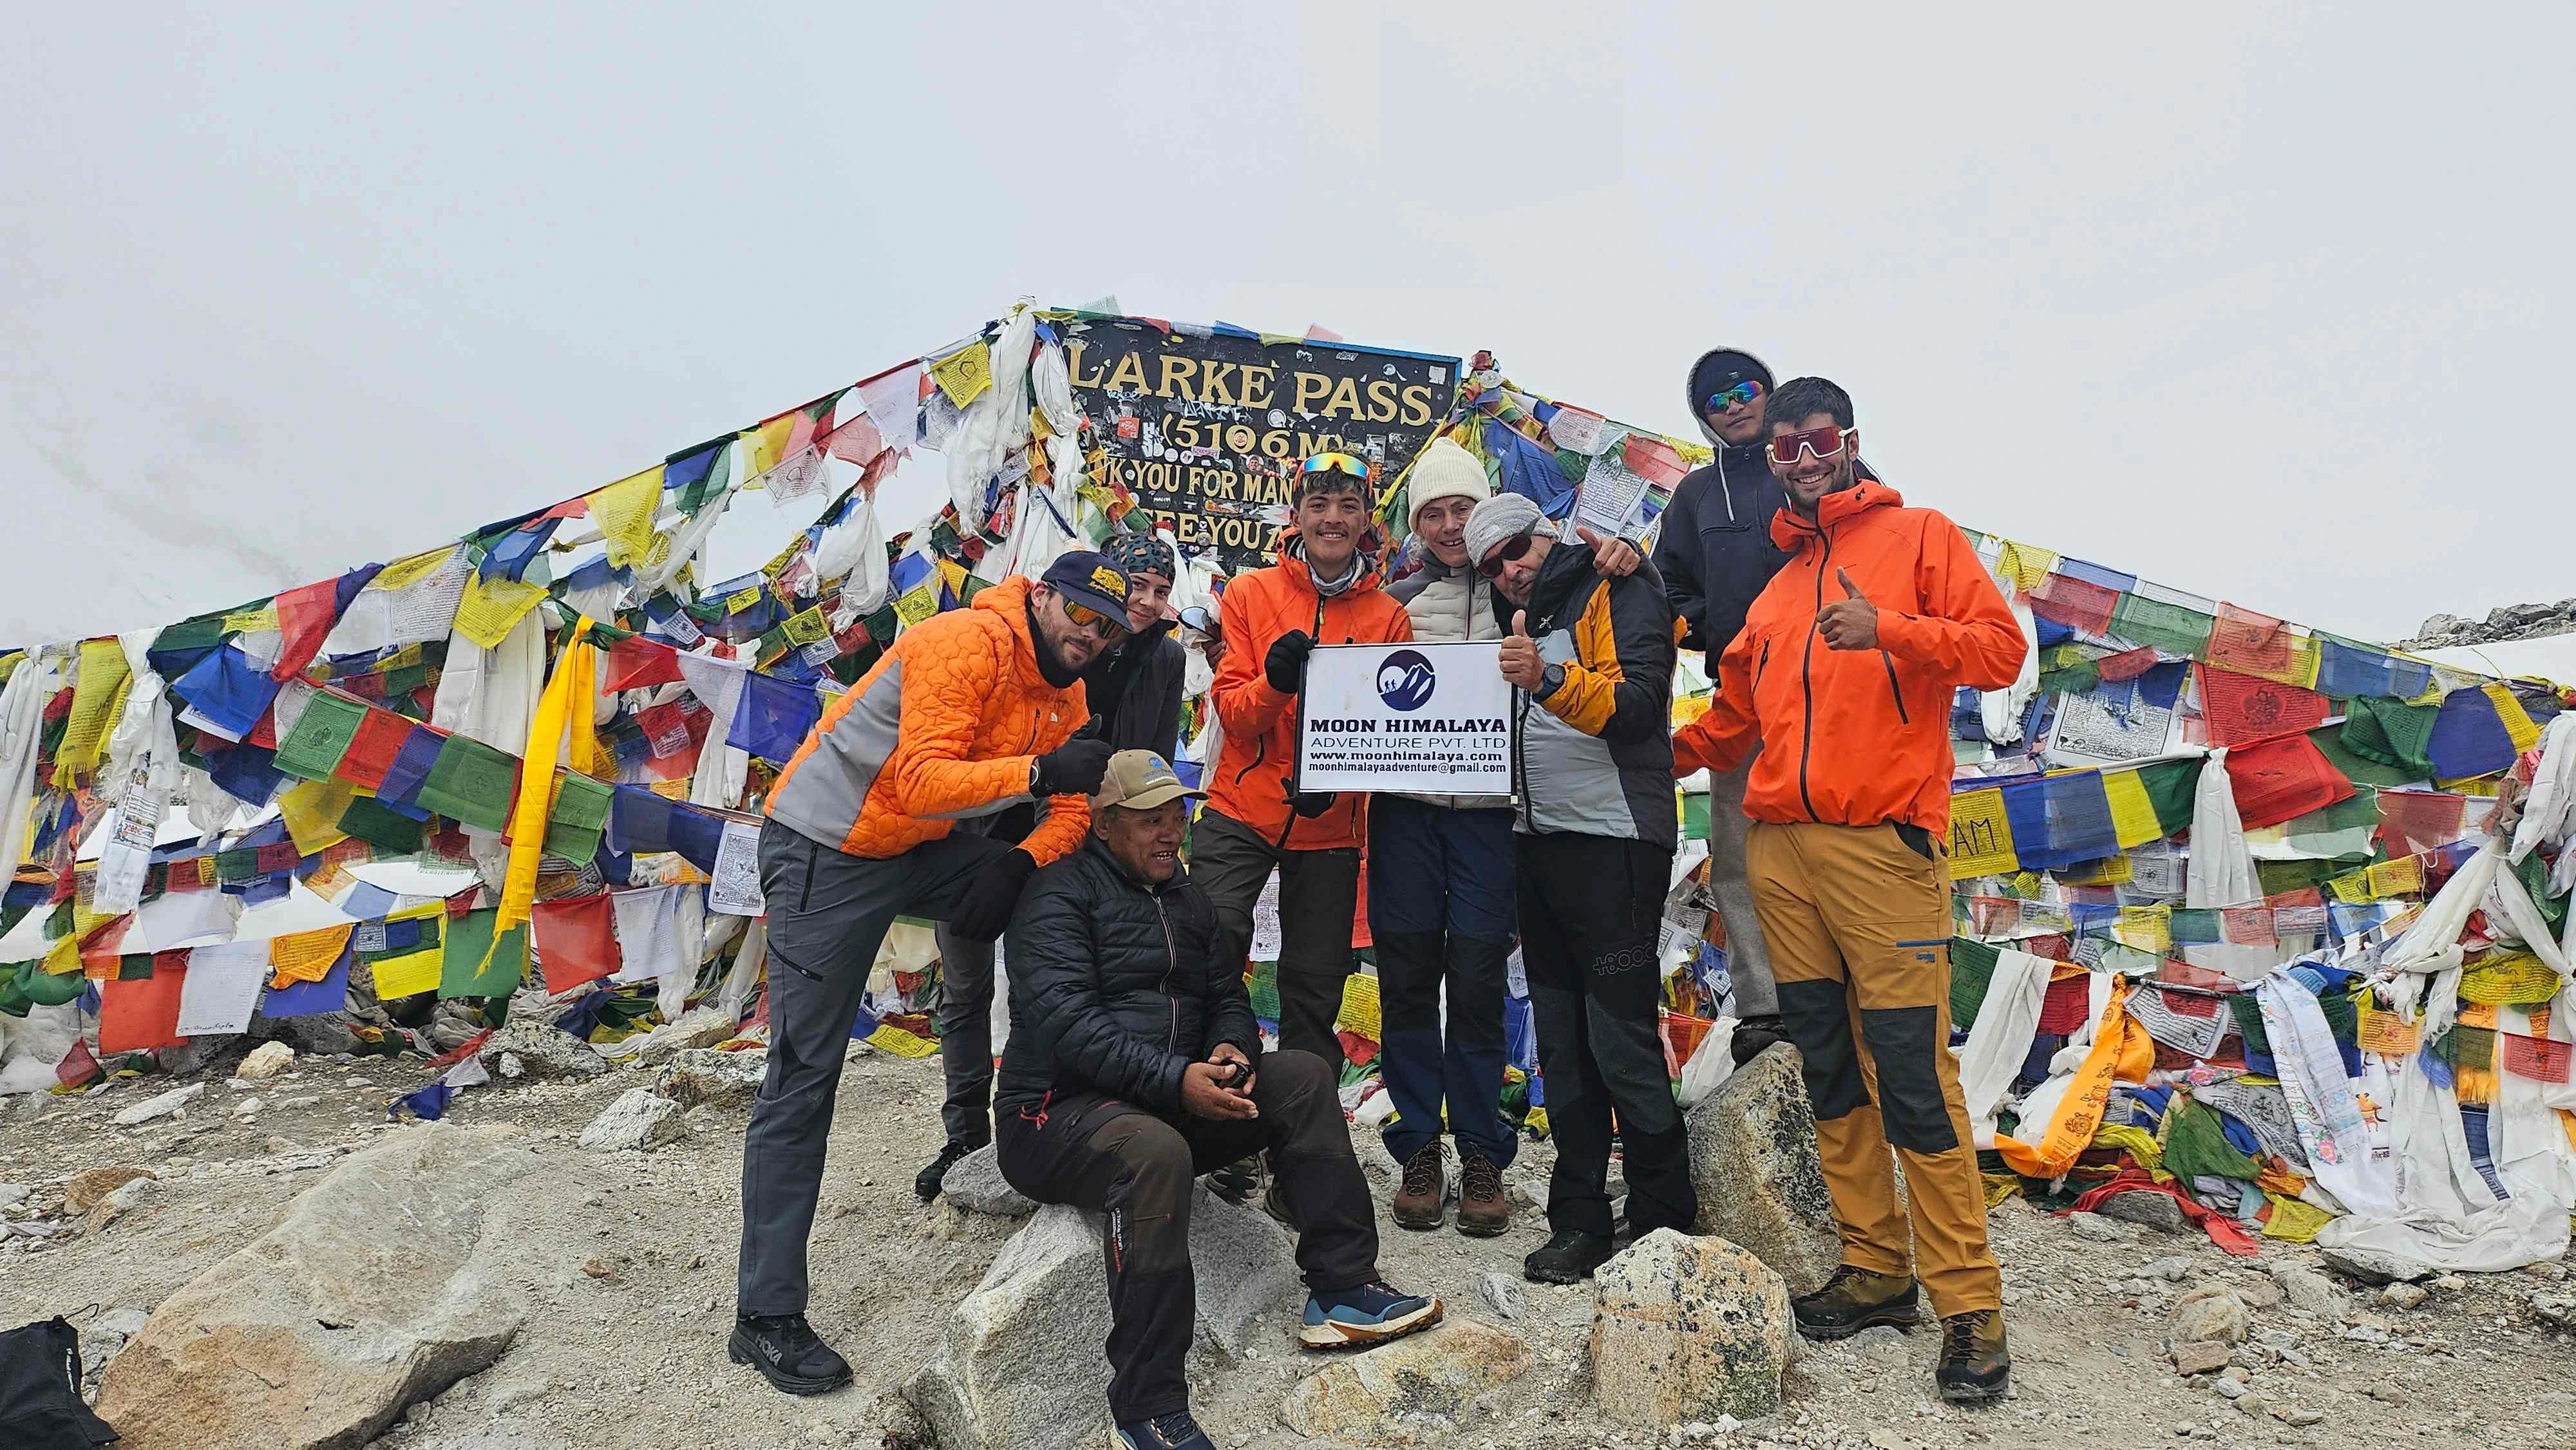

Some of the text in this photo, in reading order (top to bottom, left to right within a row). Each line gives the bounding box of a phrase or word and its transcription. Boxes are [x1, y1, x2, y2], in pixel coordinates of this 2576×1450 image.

[1065, 341, 1276, 410] LARKE
[1292, 371, 1432, 427] PASS
[1130, 459, 1182, 493] YOU
[1186, 466, 1238, 501] FOR
[1242, 473, 1294, 505] MAN
[1204, 515, 1264, 550] YOU
[1310, 718, 1507, 733] MOON HIMALAYA
[1311, 737, 1423, 748] ADVENTURE
[1428, 737, 1466, 748] PVT.
[1309, 761, 1506, 774] moonhimalayaadventure@gmail.com
[1310, 751, 1502, 762] www.moonhimalaya.com
[1953, 817, 1997, 858] AM
[754, 1333, 783, 1367] HOKA
